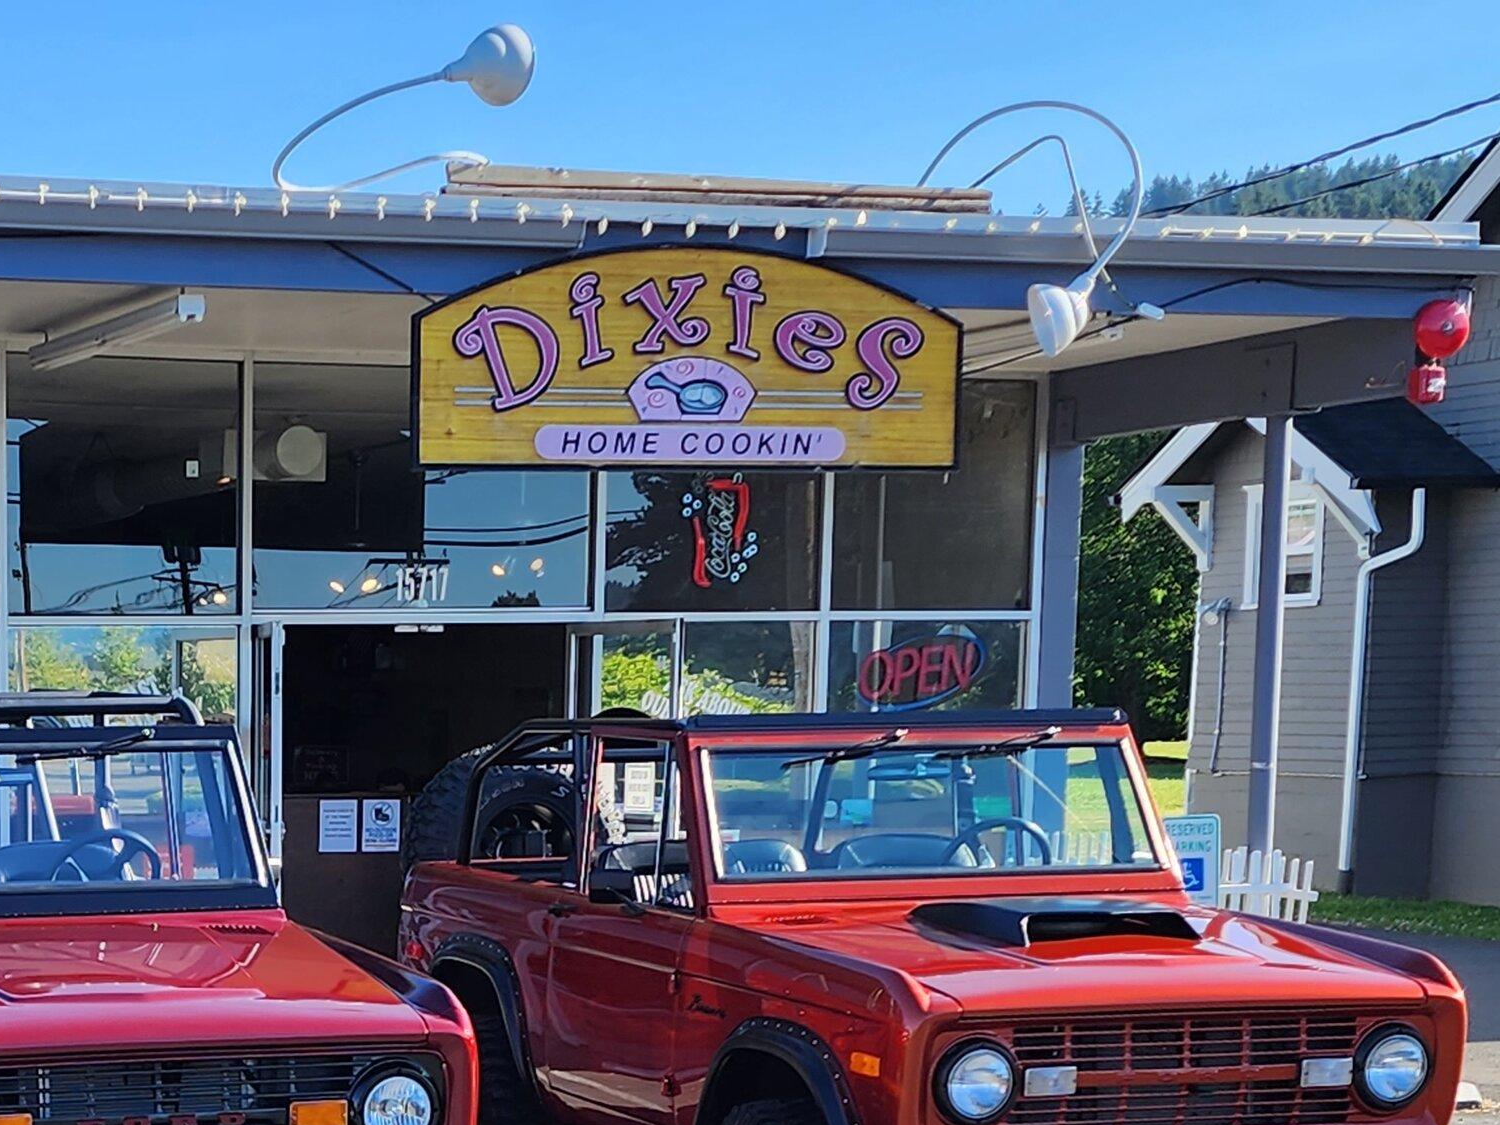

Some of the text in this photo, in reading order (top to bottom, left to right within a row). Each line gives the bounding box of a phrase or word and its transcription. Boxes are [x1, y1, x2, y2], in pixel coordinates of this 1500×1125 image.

[453, 267, 924, 411] Dixies
[561, 431, 823, 456] HOME COOKIN'
[396, 567, 449, 602] 15717
[859, 643, 975, 701] OPEN
[1175, 840, 1212, 852] ARKING
